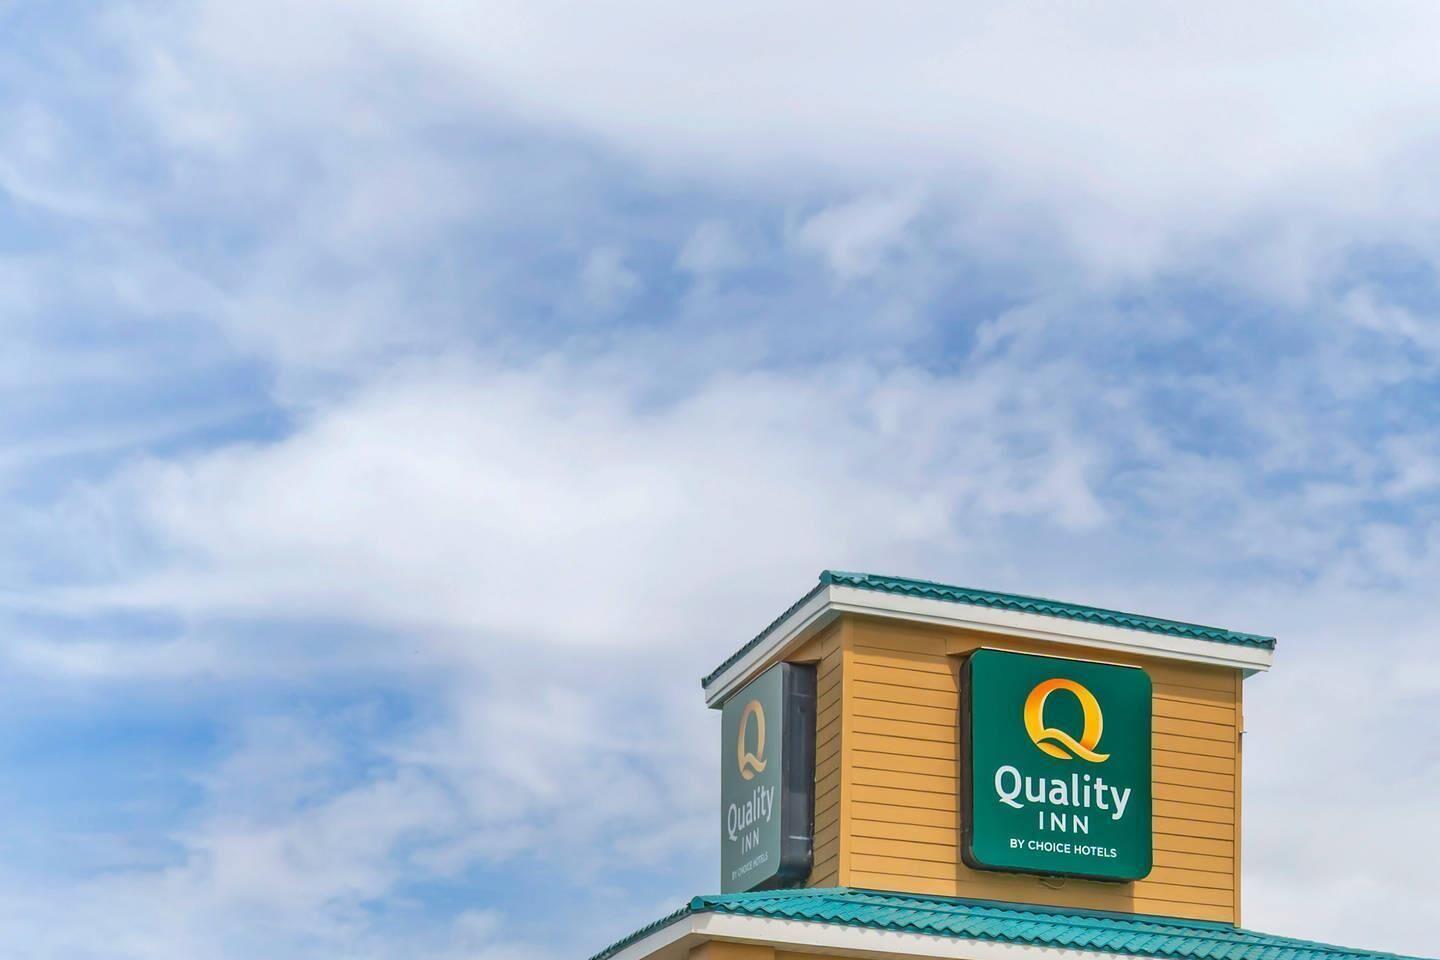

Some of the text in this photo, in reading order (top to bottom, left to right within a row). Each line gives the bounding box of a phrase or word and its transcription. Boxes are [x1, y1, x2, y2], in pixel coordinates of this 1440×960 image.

[737, 699, 767, 780] Q
[1024, 678, 1111, 763] Q
[727, 785, 775, 842] Quality
[994, 765, 1132, 820] Quality
[741, 827, 760, 855] INN
[1009, 838, 1118, 858] BY CHOICE HOTELS
[1039, 811, 1089, 835] INN
